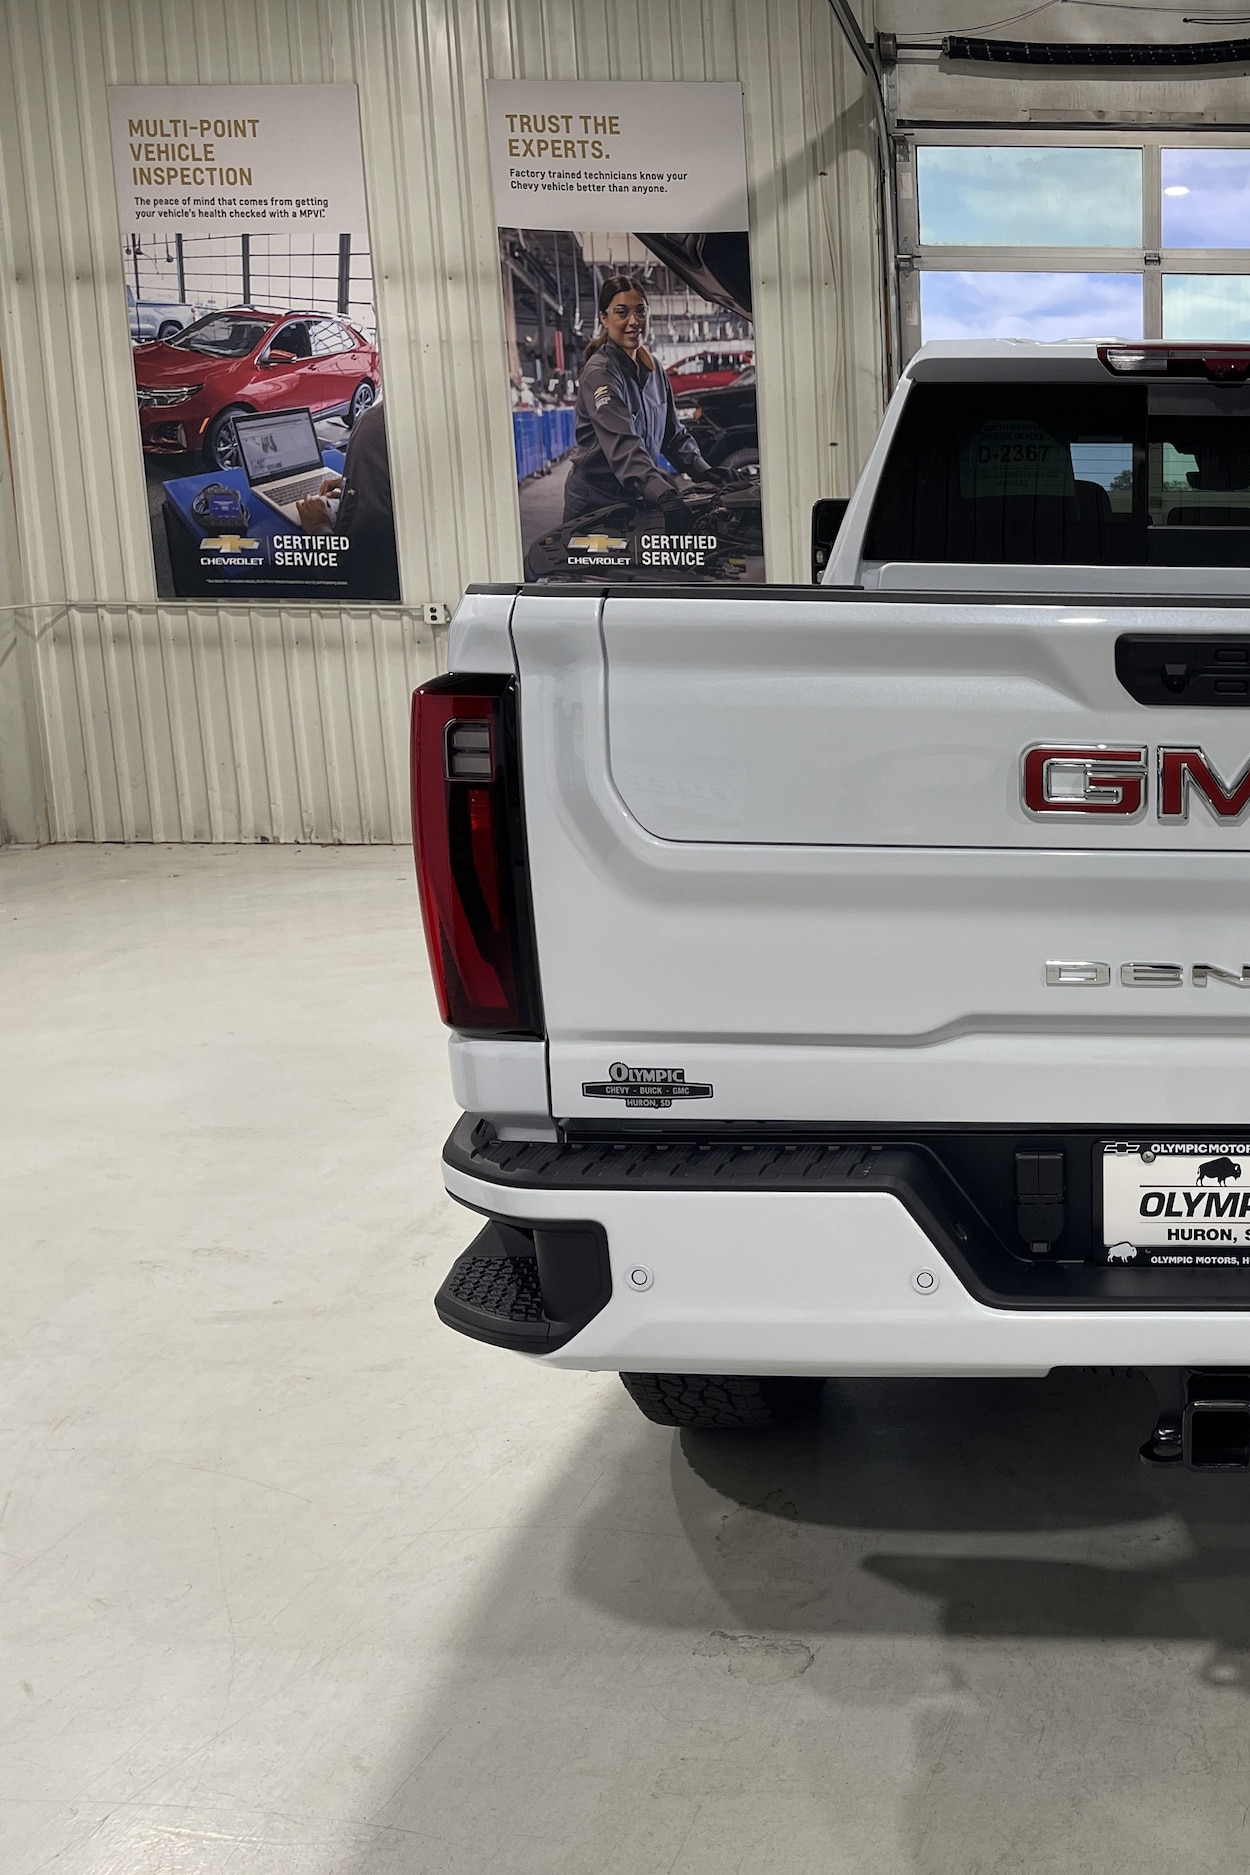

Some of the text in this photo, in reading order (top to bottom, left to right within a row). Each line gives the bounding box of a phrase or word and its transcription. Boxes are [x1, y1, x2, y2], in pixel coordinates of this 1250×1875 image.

[128, 119, 260, 138] MULTI-POINT
[505, 114, 620, 135] TRUST THE
[130, 143, 215, 162] VEHICLE
[508, 138, 611, 159] EXPERTS.
[132, 167, 253, 186] INSPECTION
[509, 168, 688, 182] Factory trained technicians know your
[510, 180, 668, 195] Chevy vehicle better than anyone.
[134, 196, 151, 206] The
[153, 198, 180, 208] peace
[181, 196, 191, 206] of
[193, 196, 215, 206] mind
[218, 197, 237, 206] that
[270, 196, 293, 206] from
[295, 197, 328, 208] getting
[135, 210, 155, 219] your
[157, 208, 196, 218] vehicle's
[198, 209, 227, 218] health
[229, 209, 266, 218] checked
[268, 209, 289, 218] with
[978, 444, 1049, 464] D-2367
[273, 535, 350, 551] CERTIFIED
[641, 535, 717, 550] CERTIFIED
[200, 557, 264, 566] CHEVROLET
[274, 552, 338, 567] SERVICE
[567, 556, 631, 566] CHEVROLET
[641, 551, 705, 566] SERVICE
[609, 1062, 685, 1083] OLYMPIC
[605, 1086, 630, 1095] CHEVY
[639, 1086, 663, 1095] BUICK
[672, 1086, 690, 1095] GMC
[627, 1099, 671, 1108] HURON, SD
[1167, 1228, 1238, 1243] HURON,
[1150, 1256, 1193, 1264] OLYMPIC
[1195, 1256, 1240, 1266] MOTORS,
